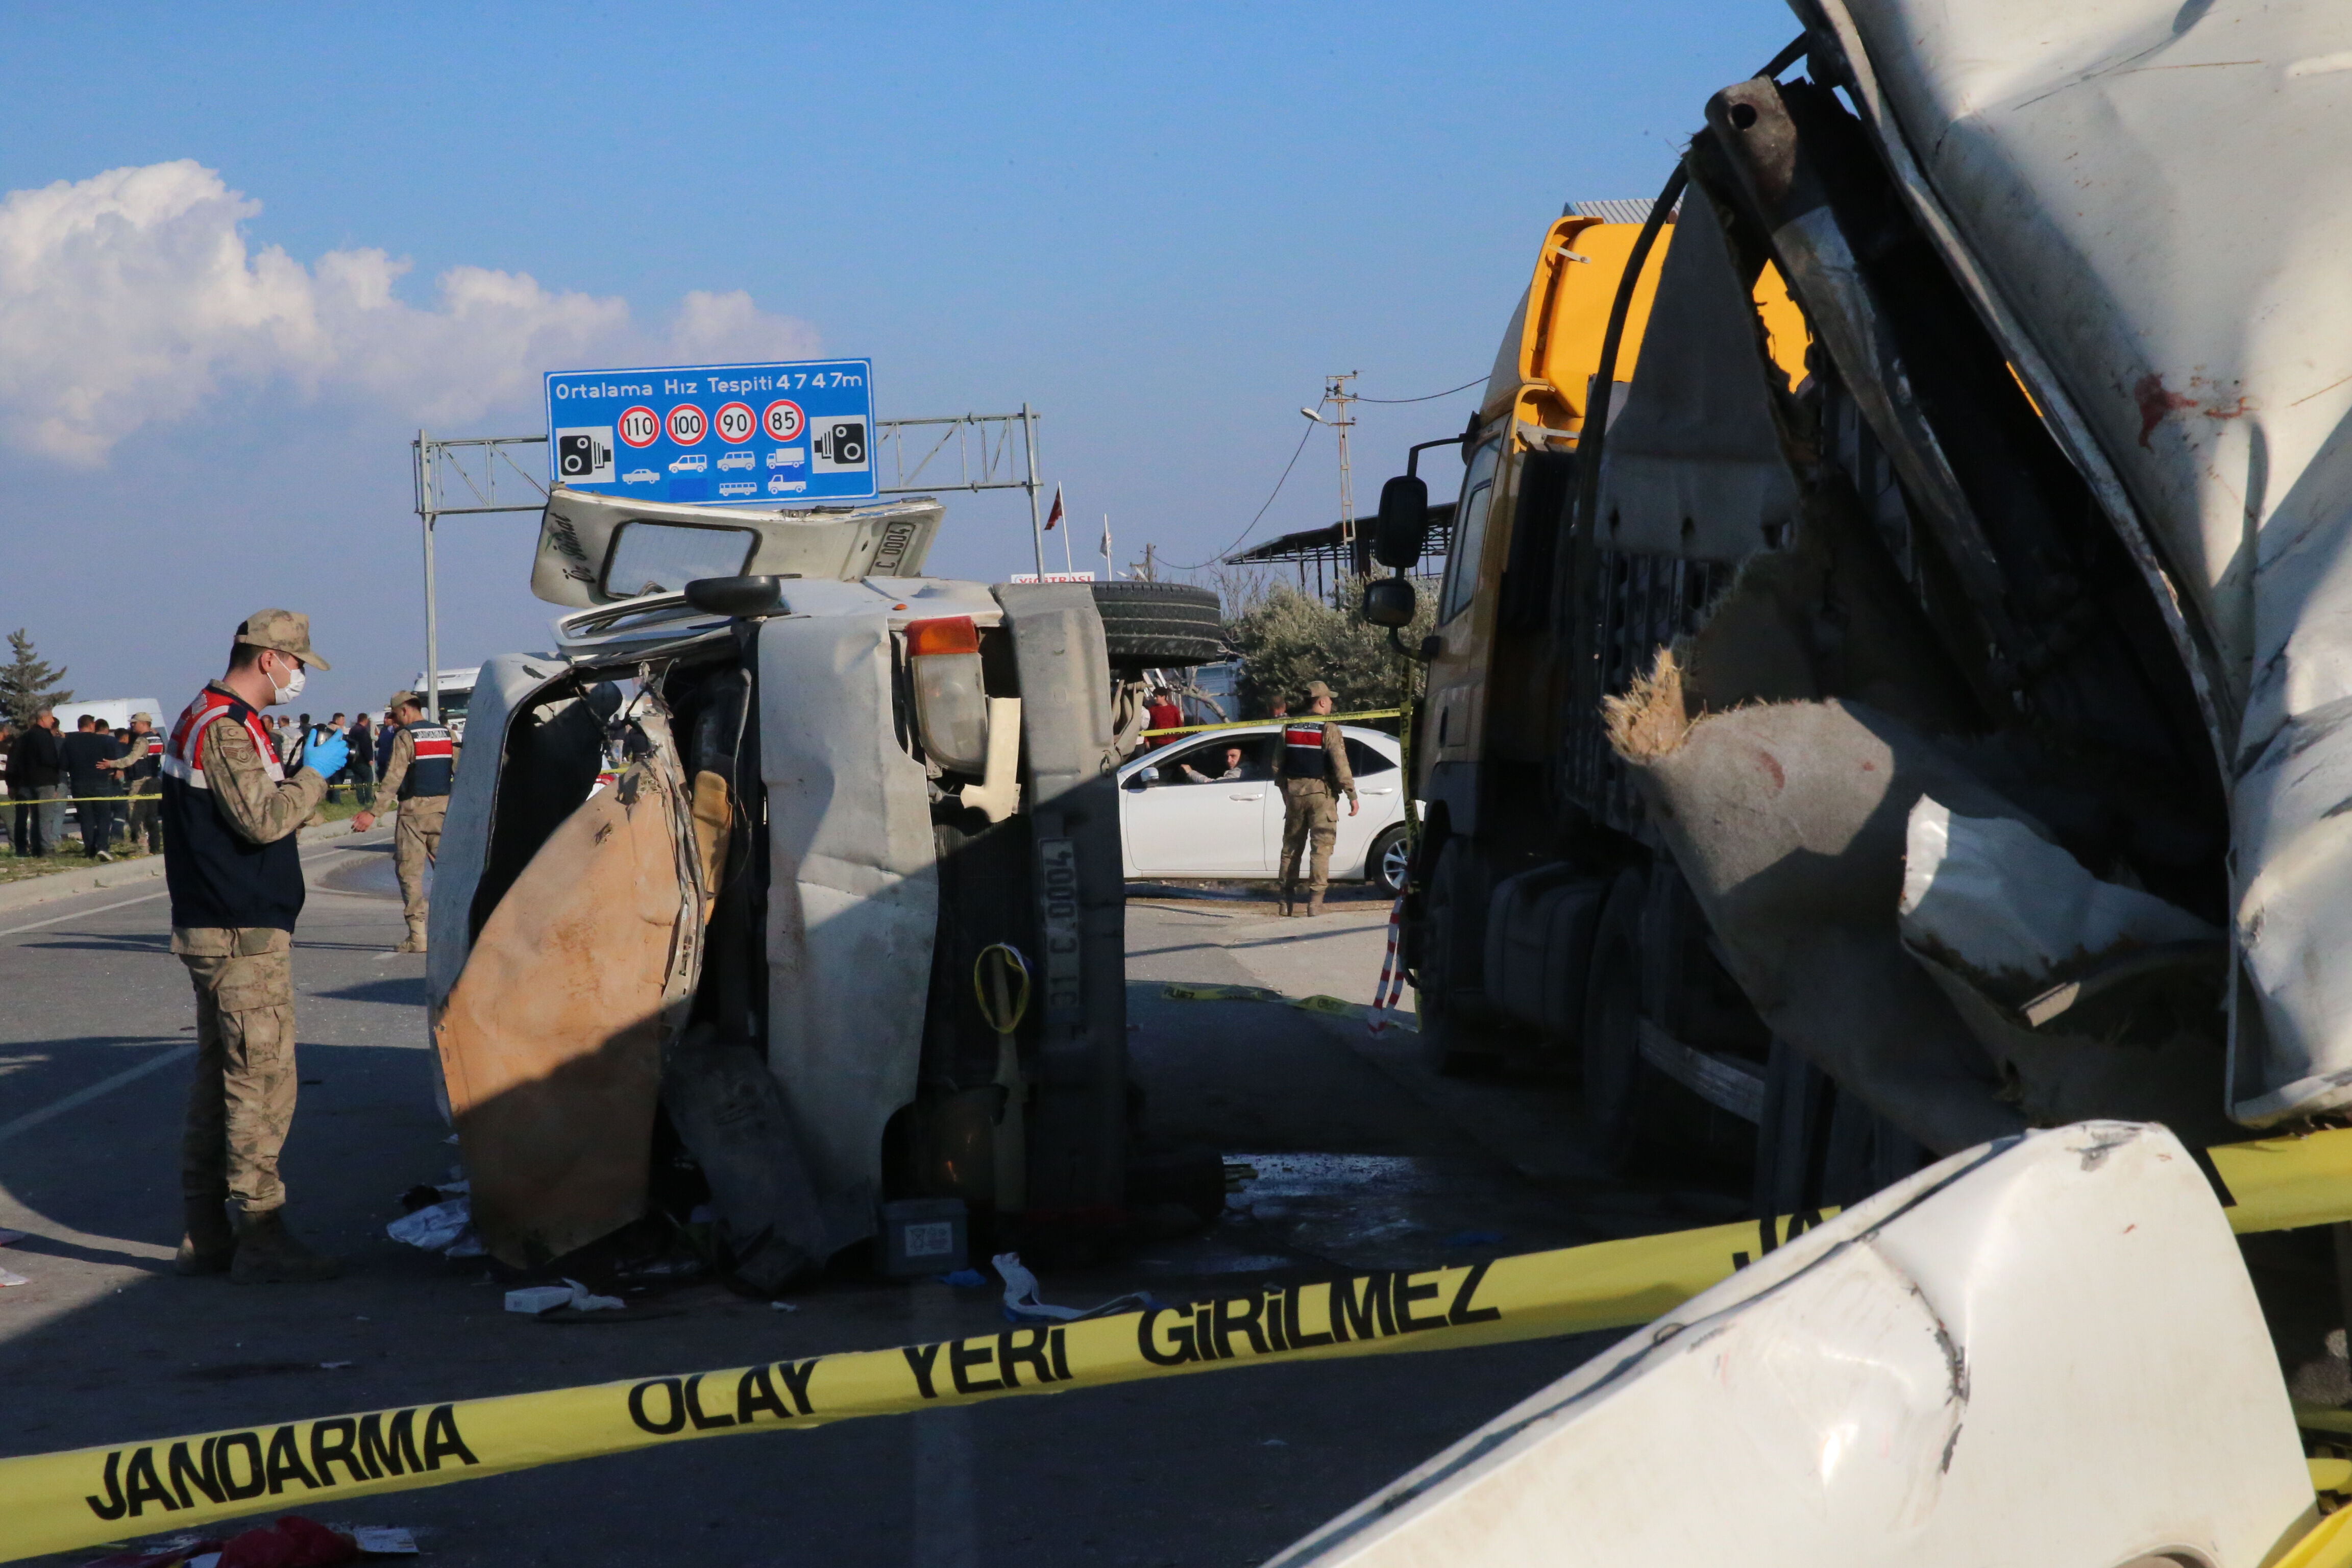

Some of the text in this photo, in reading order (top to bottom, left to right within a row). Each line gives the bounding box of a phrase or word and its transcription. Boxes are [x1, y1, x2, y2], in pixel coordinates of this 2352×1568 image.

[556, 382, 653, 400] Ortalama
[665, 379, 697, 395] Hız
[707, 376, 772, 396] Tespiti
[625, 415, 654, 437] 110
[673, 415, 701, 435] 100
[723, 414, 748, 432] 90
[772, 411, 795, 431] 85
[880, 528, 911, 555] 0004
[416, 730, 447, 739] JANDARMA
[1045, 851, 1074, 918] 0004
[86, 1404, 480, 1520] JANDARMA
[628, 1357, 821, 1435] OLAY
